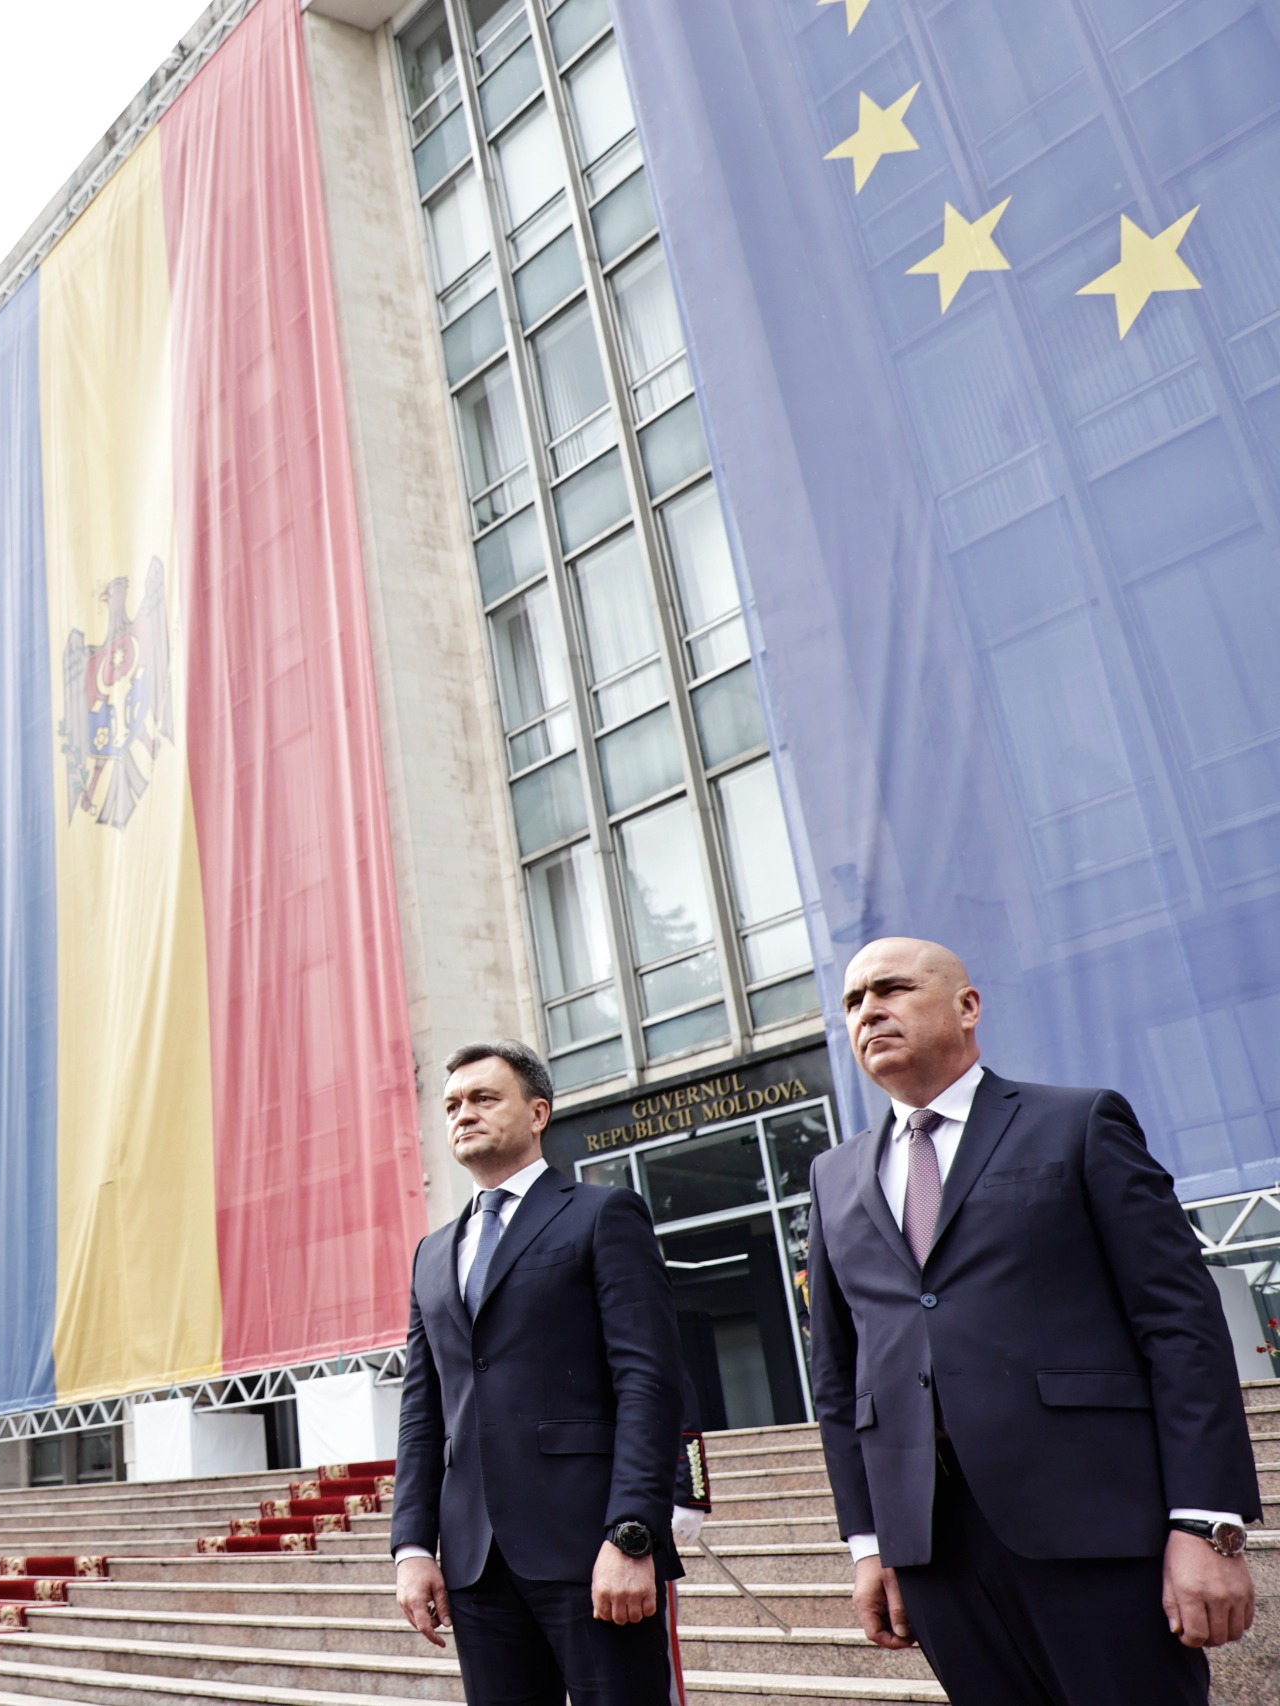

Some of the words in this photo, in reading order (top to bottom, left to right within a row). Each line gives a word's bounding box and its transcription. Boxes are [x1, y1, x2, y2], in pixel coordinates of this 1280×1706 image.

[587, 1108, 693, 1151] REPUBLICII
[702, 1078, 808, 1122] MOLDOVA
[632, 1074, 746, 1119] GUVERNUL
